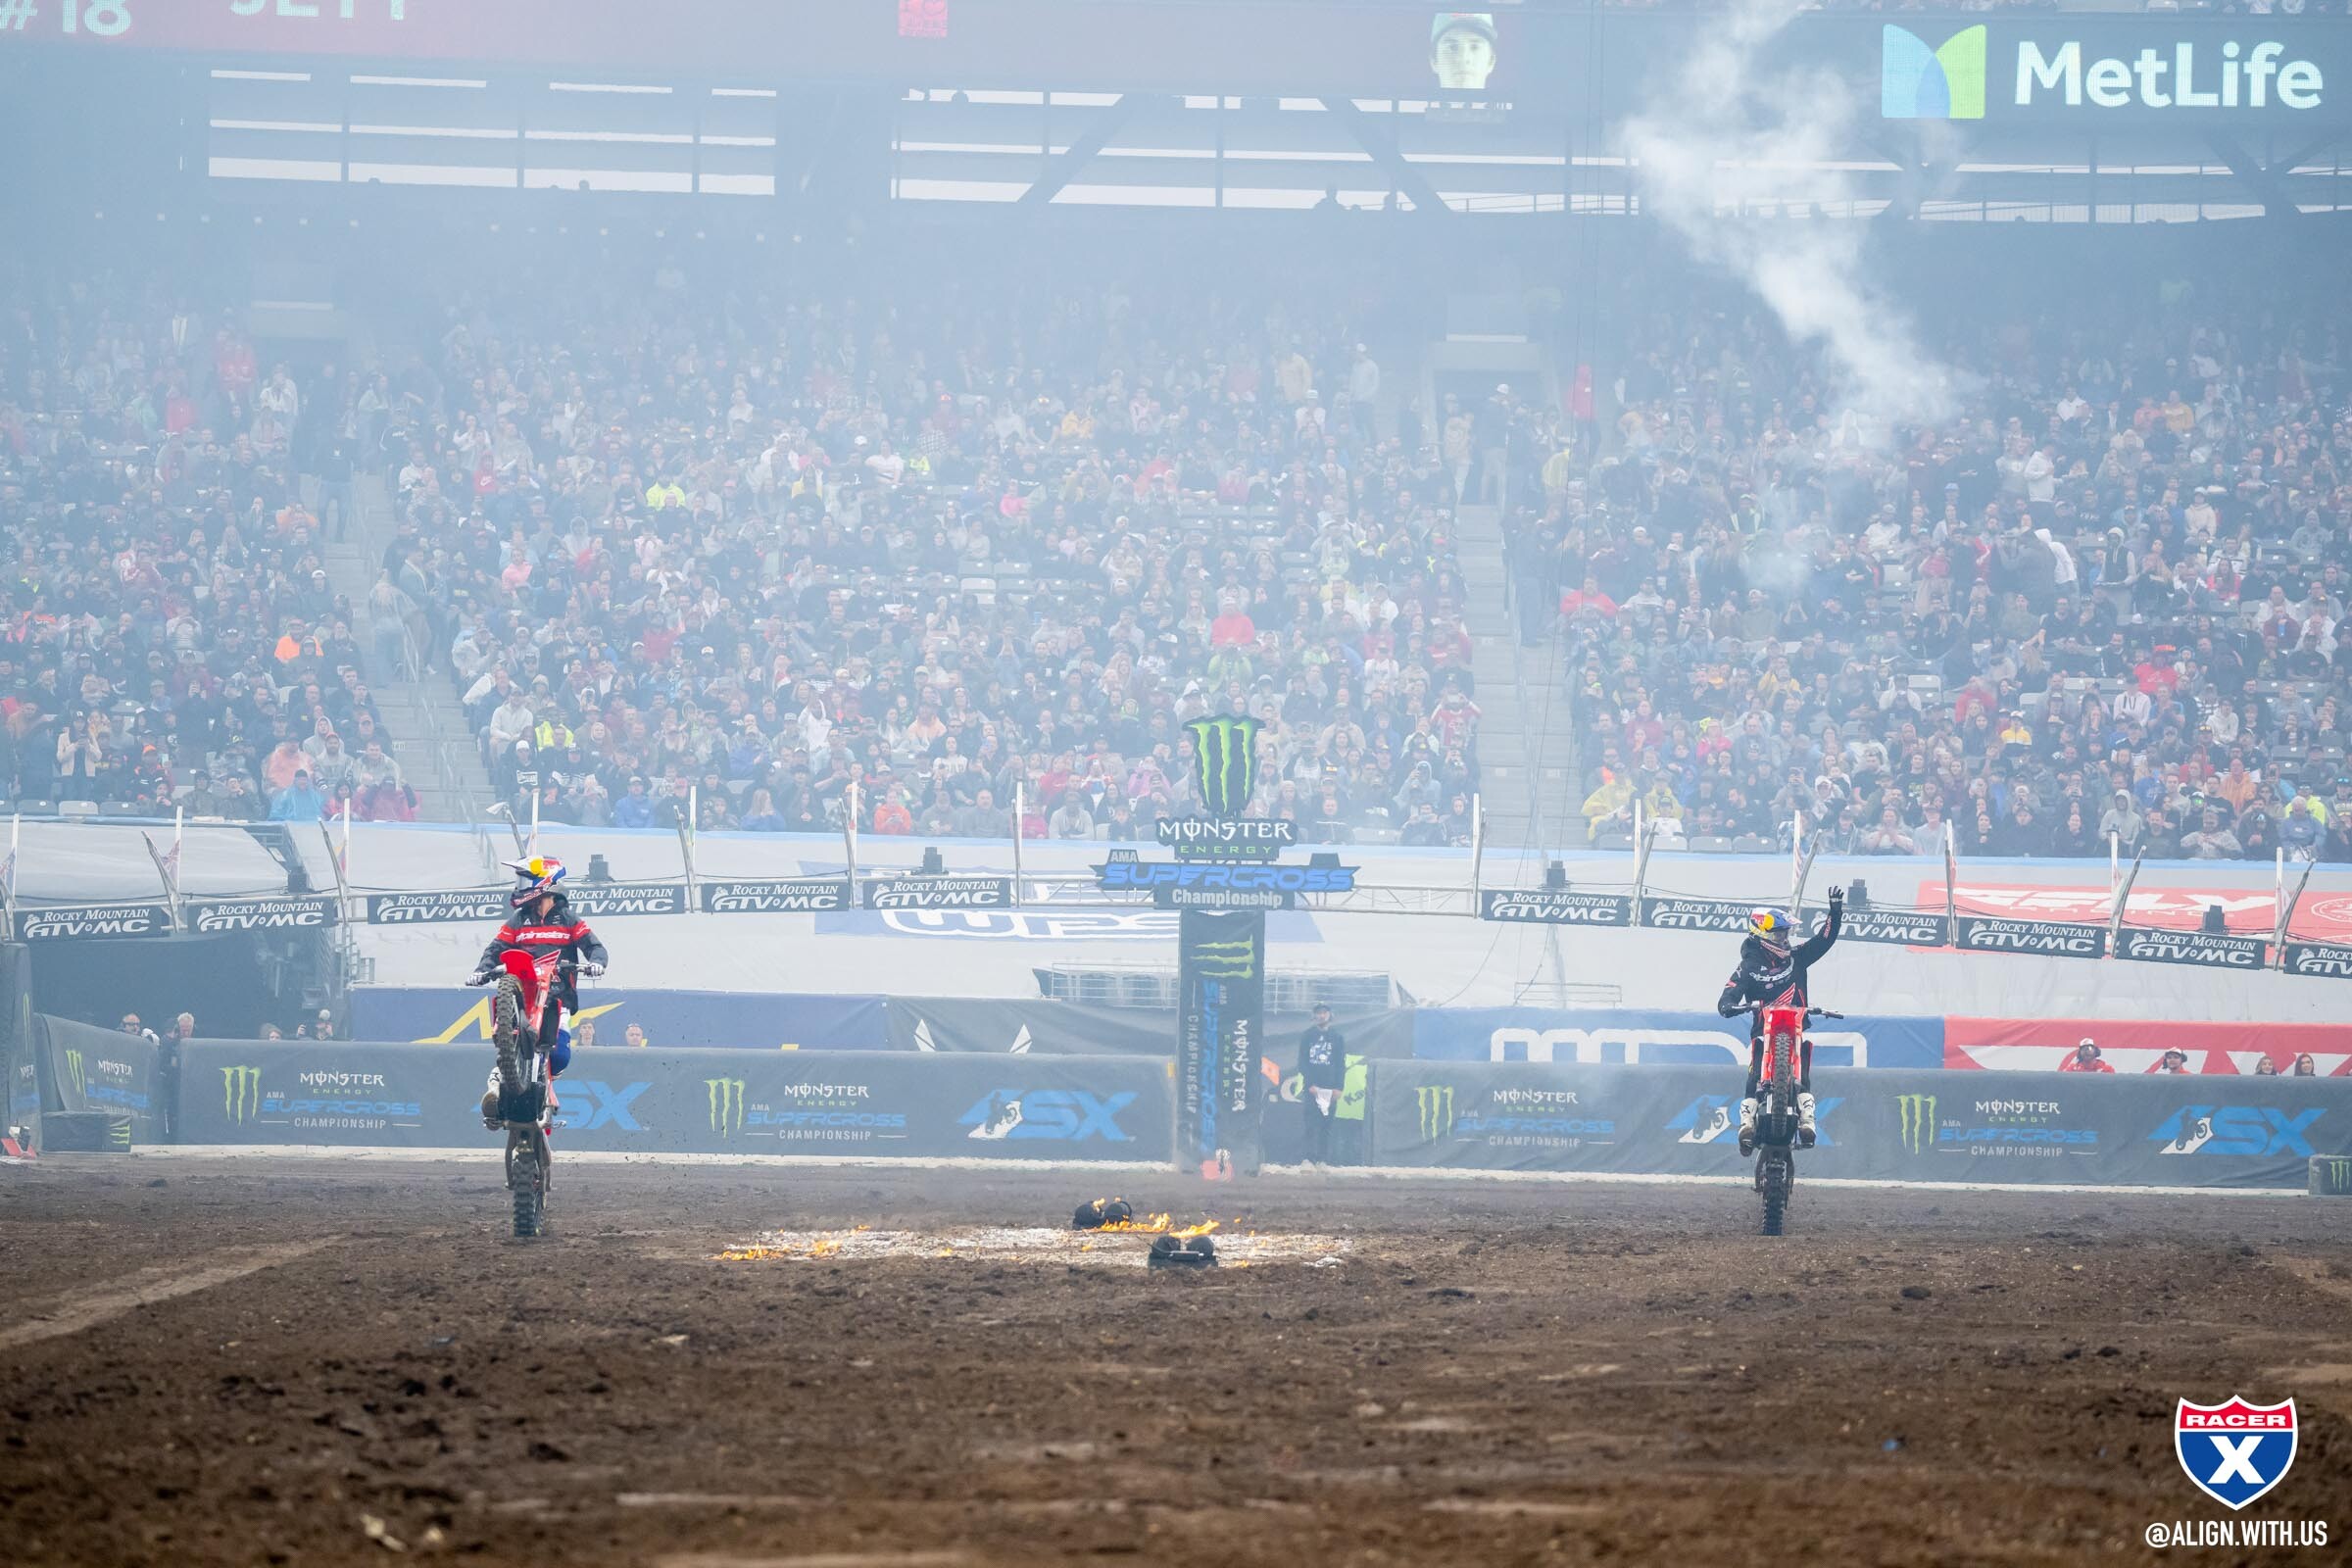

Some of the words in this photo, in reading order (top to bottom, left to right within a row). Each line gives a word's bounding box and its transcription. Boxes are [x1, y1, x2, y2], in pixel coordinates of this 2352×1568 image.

[2015, 40, 2324, 109] MetLife
[1159, 818, 1293, 841] MONSTER
[1111, 852, 1138, 862] AMA
[1103, 863, 1355, 893] SUPERCROSS
[732, 885, 770, 895] ROCKY
[772, 884, 838, 895] MOUNTAIN
[893, 881, 932, 892] ROCKY
[934, 880, 1000, 891] MOUNTAIN
[398, 895, 436, 906] ROCKY
[439, 893, 504, 904] MOUNTAIN
[568, 889, 607, 900] ROCKY
[610, 888, 674, 898] MOUNTAIN
[1172, 889, 1283, 907] Championship
[1512, 893, 1550, 904] ROCKY
[1552, 895, 1619, 907] MOUNTAIN
[44, 909, 83, 922] ROCKY
[84, 907, 150, 920] MOUNTAIN
[218, 905, 258, 915] ROCKY
[259, 902, 323, 913] MOUNTAIN
[1672, 901, 1711, 913] ROCKY
[1713, 904, 1753, 916] MOUN
[1840, 912, 1874, 923] OCKY
[1876, 913, 1937, 927] MOUNTAIN
[1989, 920, 2030, 933] ROCKY
[2032, 923, 2096, 938] MOUNTAIN
[2150, 932, 2188, 945] ROCKY
[2190, 936, 2256, 951] MOUNTAIN
[300, 1070, 384, 1087] MONSTER
[784, 1082, 869, 1099] MONSTER
[1494, 1088, 1578, 1104] MONSTER
[261, 1100, 421, 1115] SUPERCROSS
[1975, 1099, 2061, 1115] MONSTER
[294, 1117, 386, 1129] CHAMPIONSHIP
[746, 1111, 906, 1127] SUPERCROSS
[779, 1130, 871, 1142] CHAMPIONSHIP
[1489, 1135, 1581, 1148] CHAMPIONSHIP
[1937, 1128, 2099, 1144] SUPERCROSS
[1971, 1146, 2063, 1157] CHAMPIONSHIP
